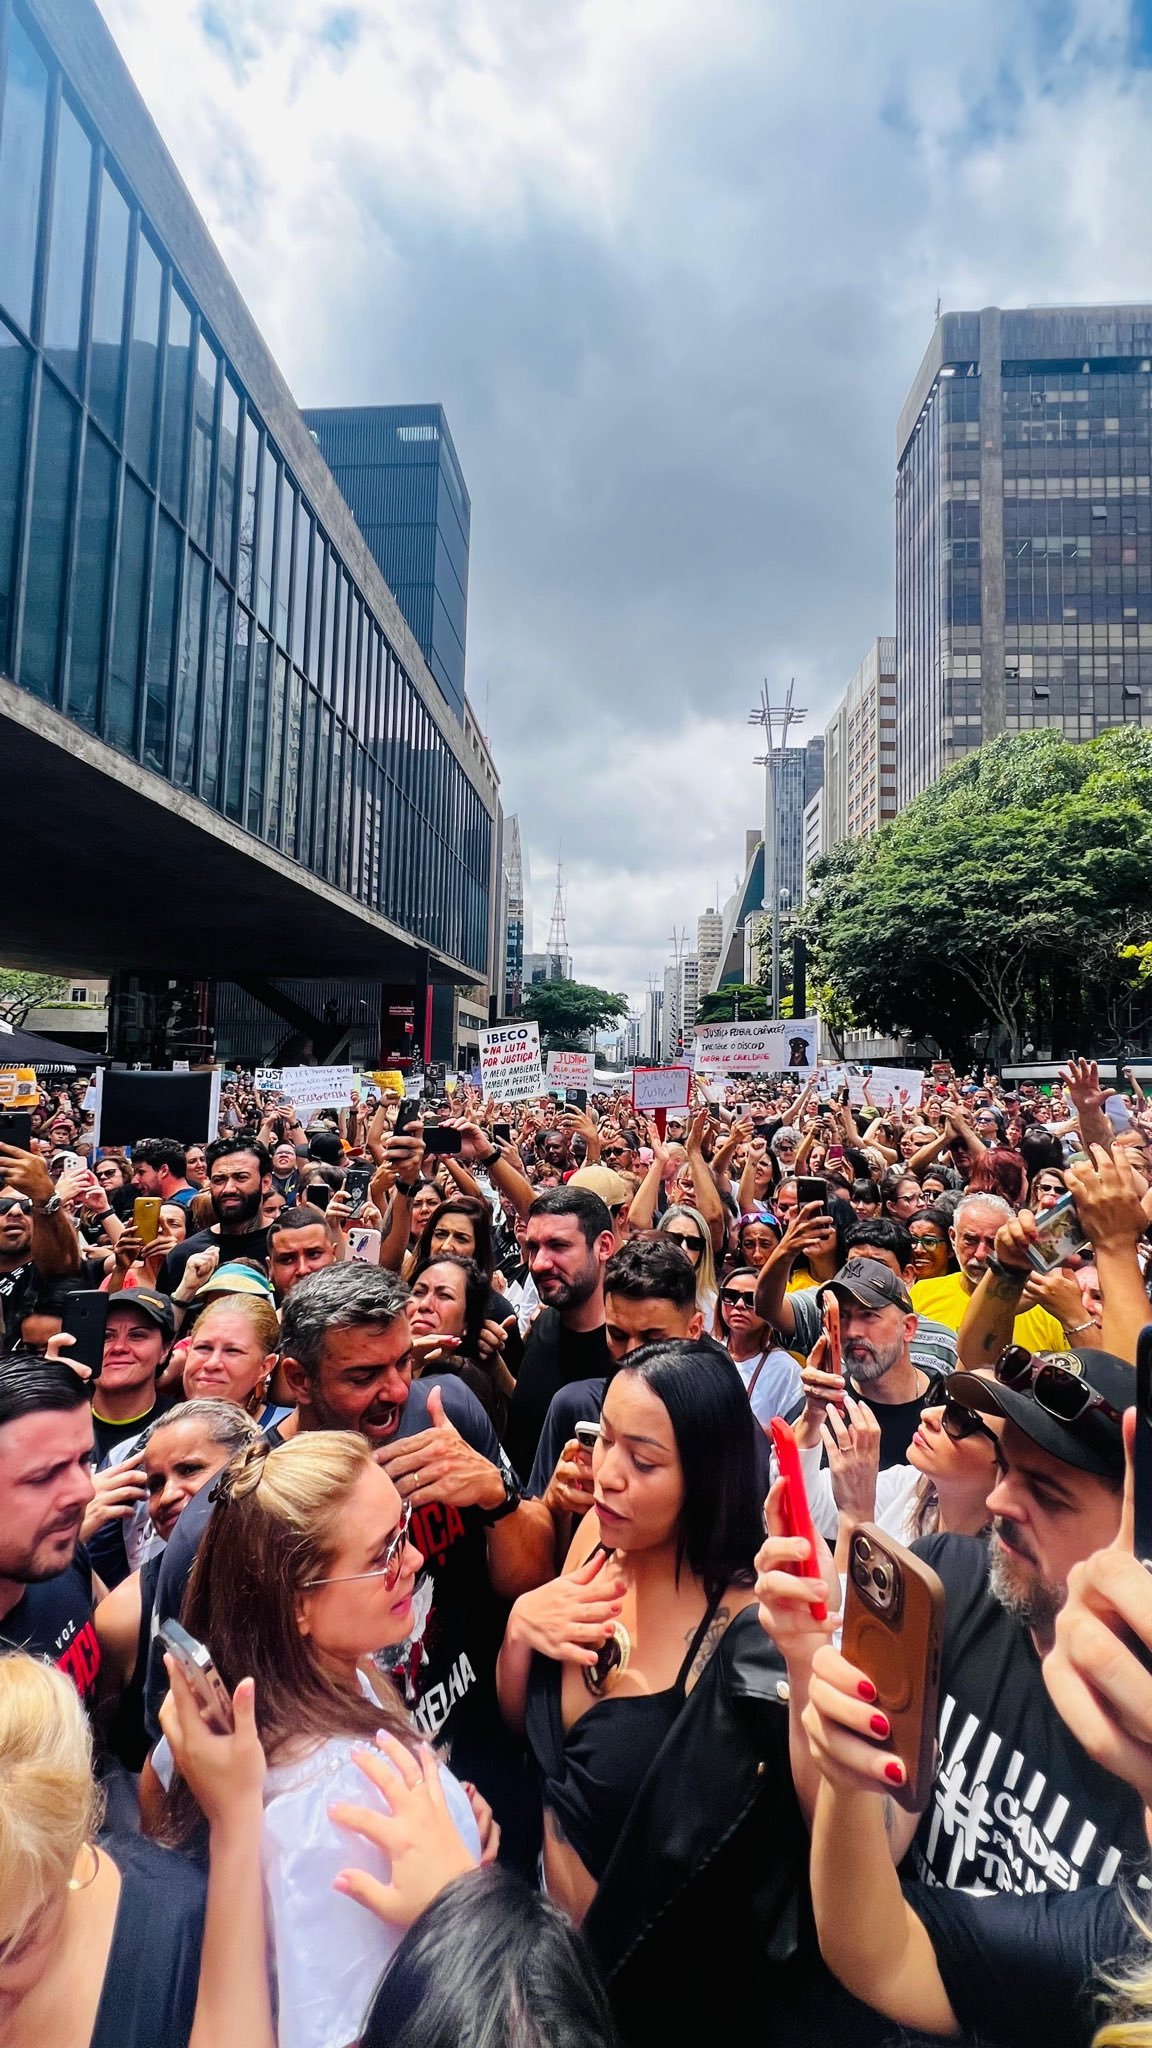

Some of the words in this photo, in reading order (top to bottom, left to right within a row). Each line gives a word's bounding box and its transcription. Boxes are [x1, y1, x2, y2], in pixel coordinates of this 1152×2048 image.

[487, 1029, 528, 1044] IBECO
[490, 1046, 501, 1055] NA
[505, 1042, 526, 1052] LUTA
[483, 1058, 498, 1067] POR
[483, 1071, 487, 1079] O
[490, 1068, 506, 1078] MEIO
[509, 1063, 540, 1075] AMBIENTE
[513, 1073, 540, 1085] PERTENCE
[55, 1620, 76, 1650] VOZ
